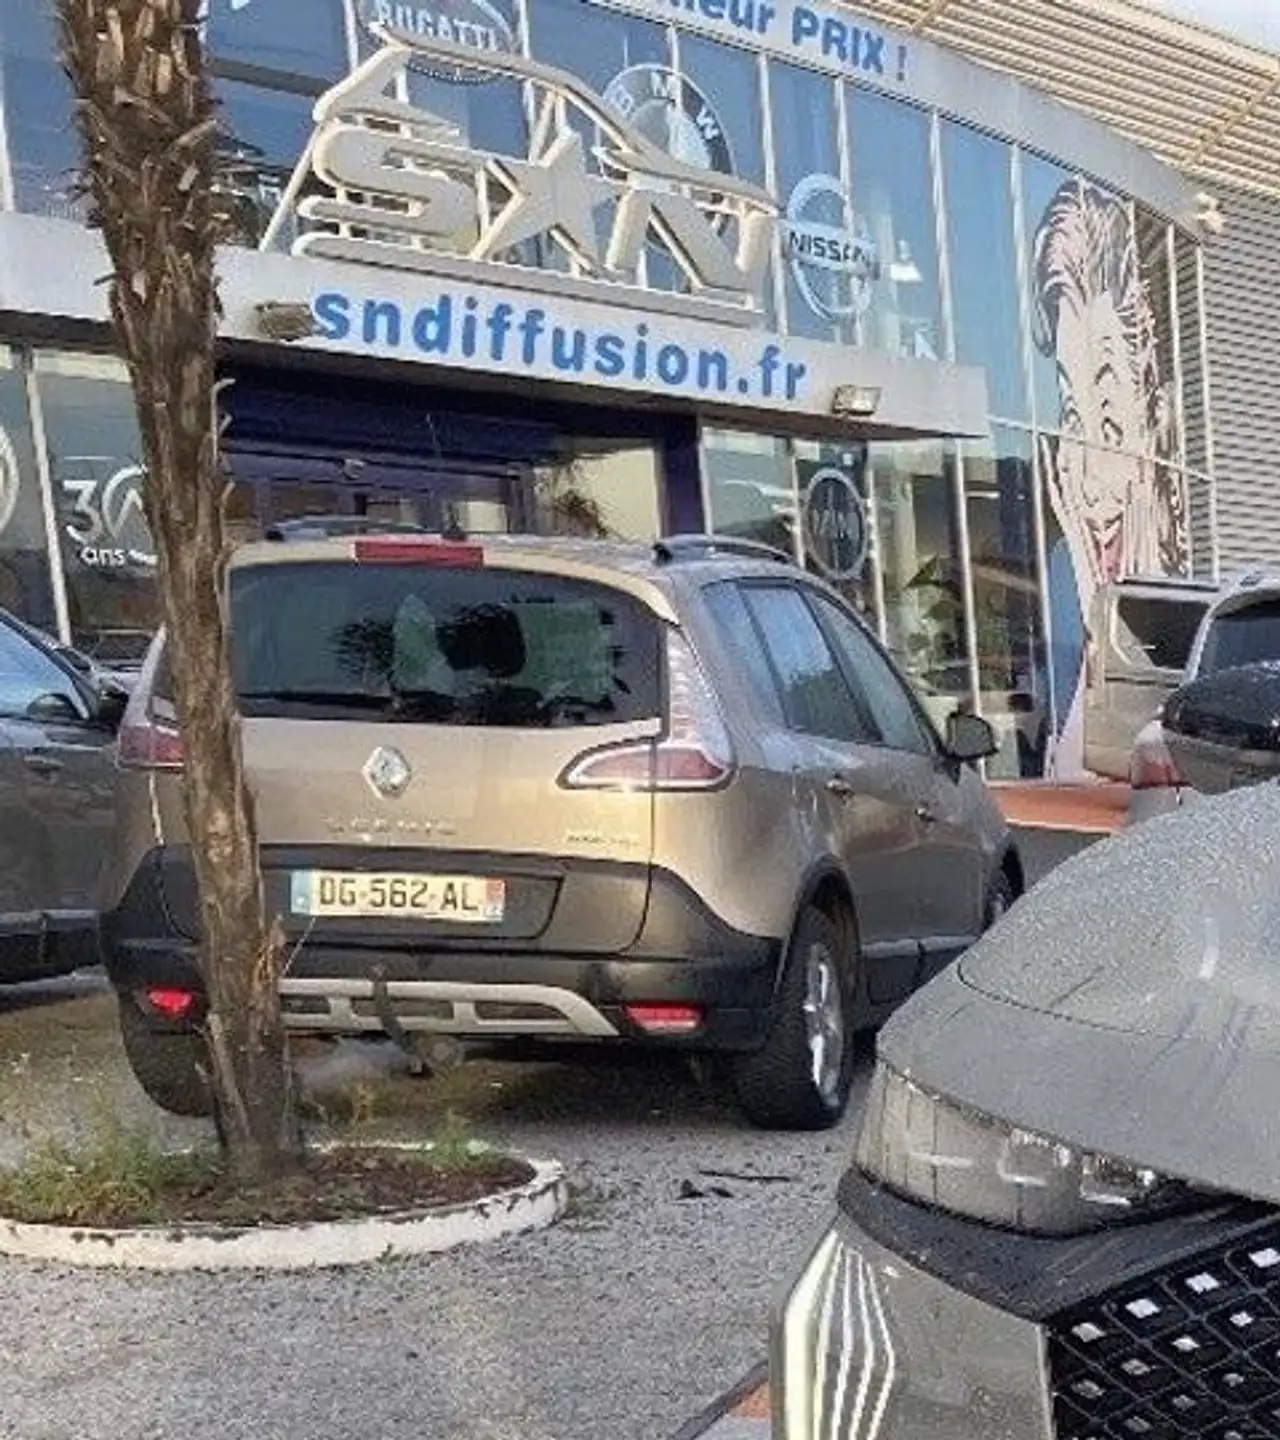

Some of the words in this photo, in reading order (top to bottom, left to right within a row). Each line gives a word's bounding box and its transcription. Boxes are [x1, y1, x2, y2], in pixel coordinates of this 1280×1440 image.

[791, 7, 884, 73] PRIX
[895, 45, 907, 81] !
[313, 290, 806, 399] sndiffusion.fr
[79, 546, 126, 566] ans
